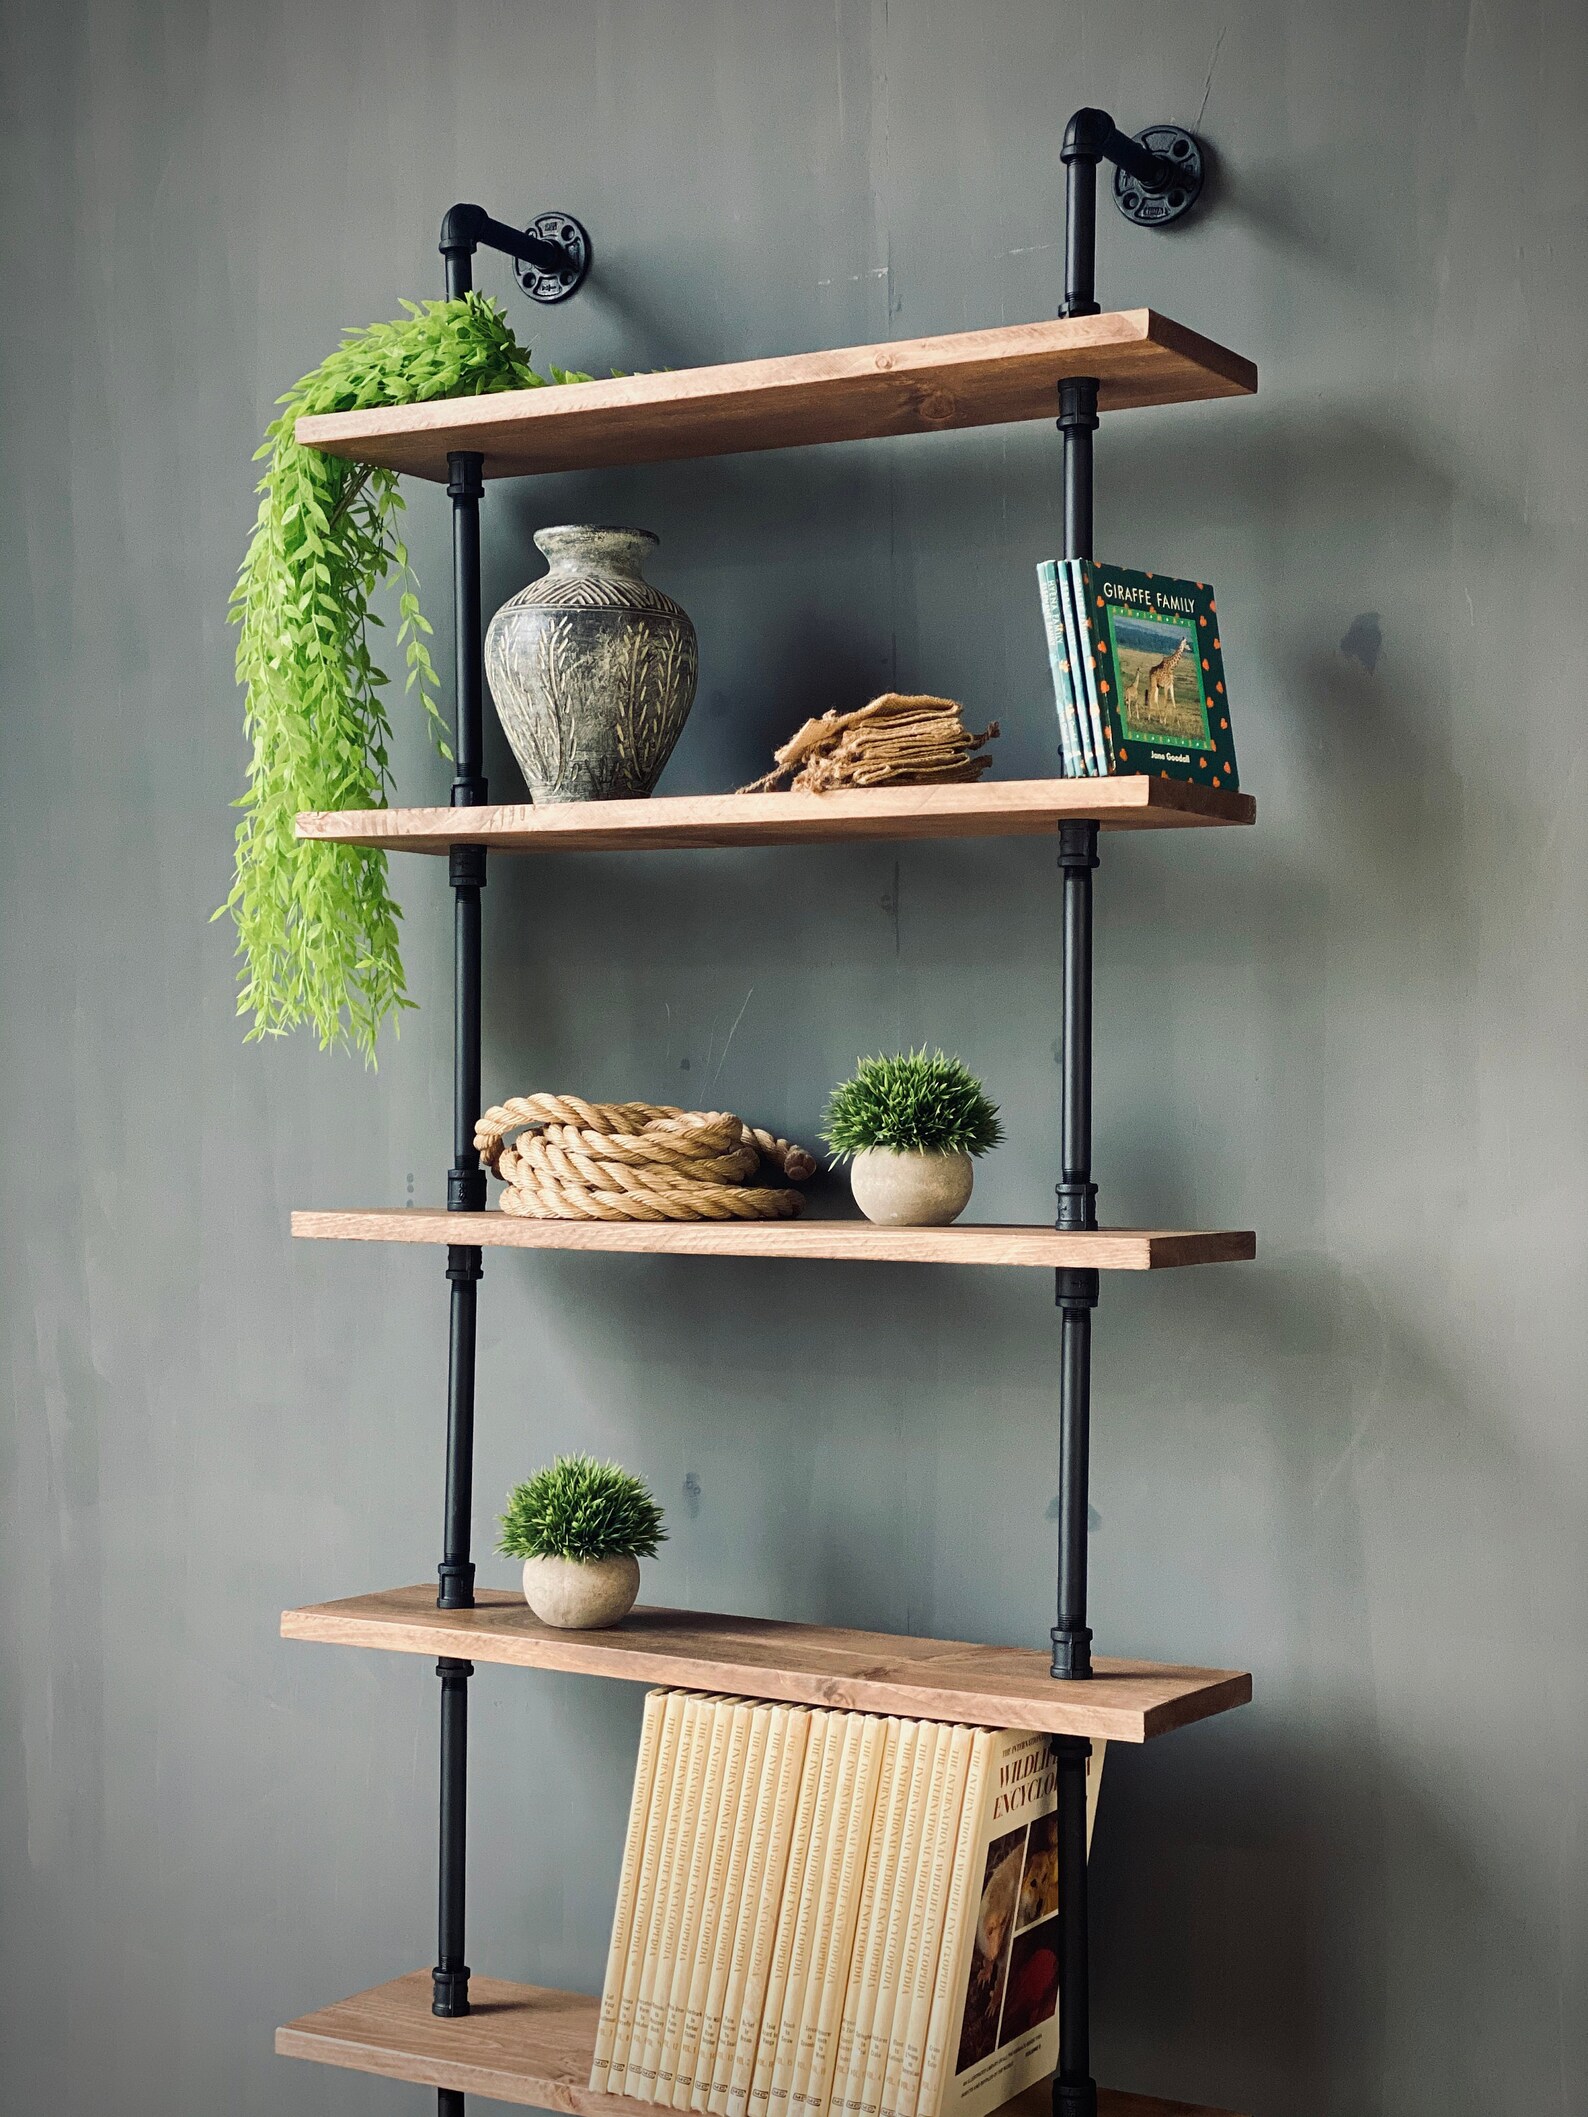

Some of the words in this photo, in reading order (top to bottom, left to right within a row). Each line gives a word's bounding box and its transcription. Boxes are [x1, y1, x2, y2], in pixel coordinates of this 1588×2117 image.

[1047, 579, 1059, 610] HYENA
[1103, 582, 1152, 605] GIRAFFE
[1156, 593, 1195, 613] FAMILY
[1052, 613, 1063, 643] FAMILY
[1151, 750, 1165, 760] Jane
[1166, 752, 1190, 763] Goodall
[646, 1712, 656, 1731] THE
[666, 1716, 675, 1735] THE
[697, 1720, 707, 1739] THE
[714, 1722, 724, 1741] THE
[733, 1724, 743, 1743] THE
[751, 1729, 761, 1749] THE
[771, 1731, 781, 1750] THE
[811, 1737, 821, 1756] THE
[827, 1734, 837, 1753] THE
[885, 1738, 896, 1758] THE
[901, 1740, 912, 1760] THE
[917, 1742, 927, 1762] THE
[936, 1746, 946, 1766] THE
[949, 1749, 959, 1768] THE
[633, 1735, 652, 1817] INTERNATIONAL
[683, 1743, 703, 1826] INTERNATIONAL
[700, 1744, 720, 1827] INTERNATIONAL
[719, 1747, 740, 1830] INTERNATIONAL
[737, 1752, 757, 1836] INTERNATIONAL
[756, 1754, 777, 1837] INTERNATIONAL
[814, 1757, 834, 1841] INTERNATIONAL
[797, 1760, 817, 1843] INTERNATIONAL
[888, 1764, 908, 1849] INTERNATIONAL
[903, 1766, 923, 1851] INTERNATIONAL
[922, 1770, 943, 1856] INTERNATIONAL
[936, 1772, 955, 1859] INTERNATIONAL
[625, 1820, 639, 1869] WILDLIFE
[675, 1829, 690, 1879] WILDLIFE
[692, 1830, 706, 1880] WILDLIFE
[711, 1834, 726, 1884] WILDLIFE
[728, 1839, 743, 1889] WILDLIFE
[747, 1841, 763, 1891] WILDLIFE
[805, 1844, 820, 1895] WILDLIFE
[788, 1847, 803, 1897] WILDLIFE
[880, 1853, 895, 1904] WILDLIFE
[895, 1855, 910, 1906] WILDLIFE
[914, 1859, 929, 1911] WILDLIFE
[928, 1862, 942, 1914] WILDLIFE
